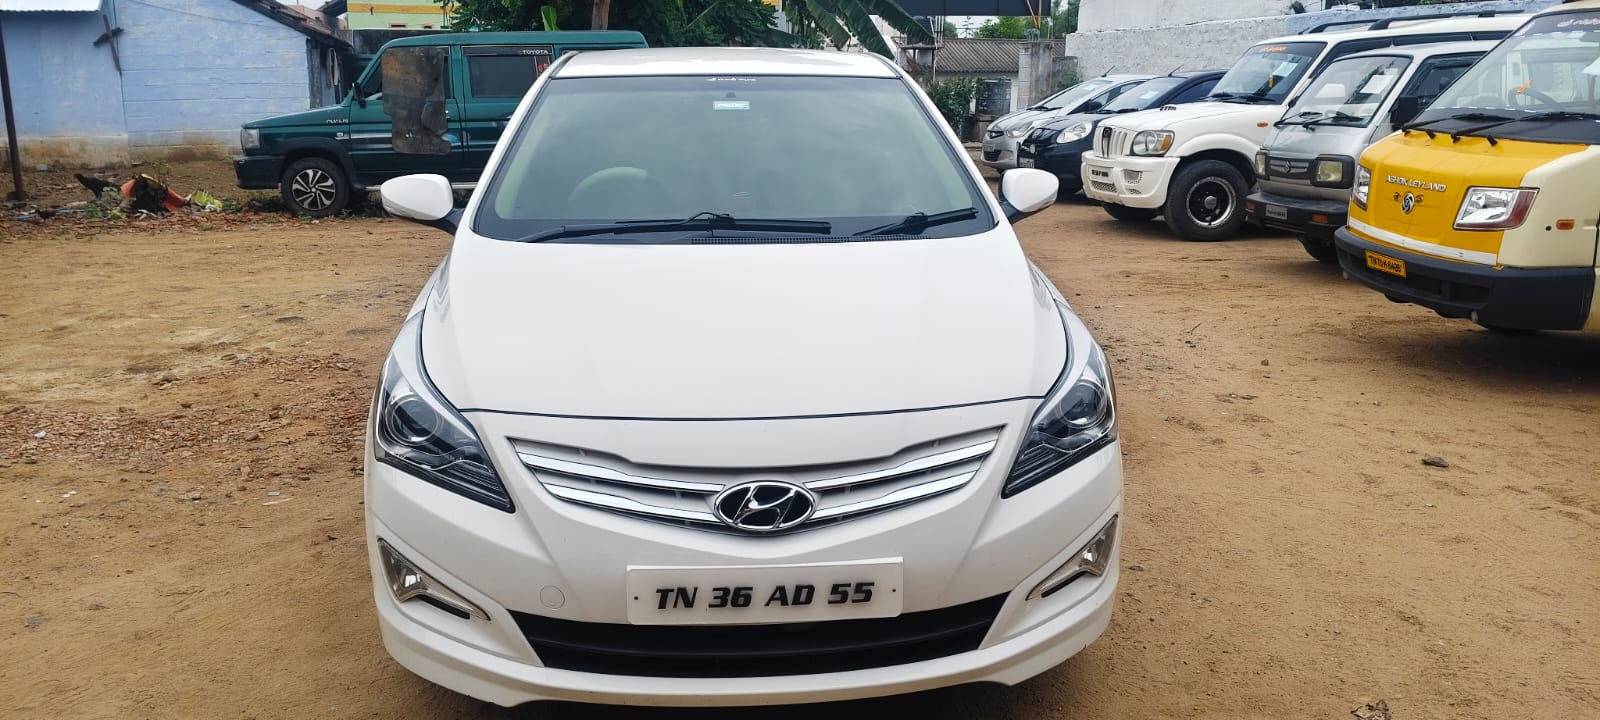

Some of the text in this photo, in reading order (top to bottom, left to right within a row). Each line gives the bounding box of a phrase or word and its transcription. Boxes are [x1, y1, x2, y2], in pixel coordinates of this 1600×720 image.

[1408, 179, 1446, 191] LEYLAND
[655, 582, 875, 610] TN 36 AD 55
